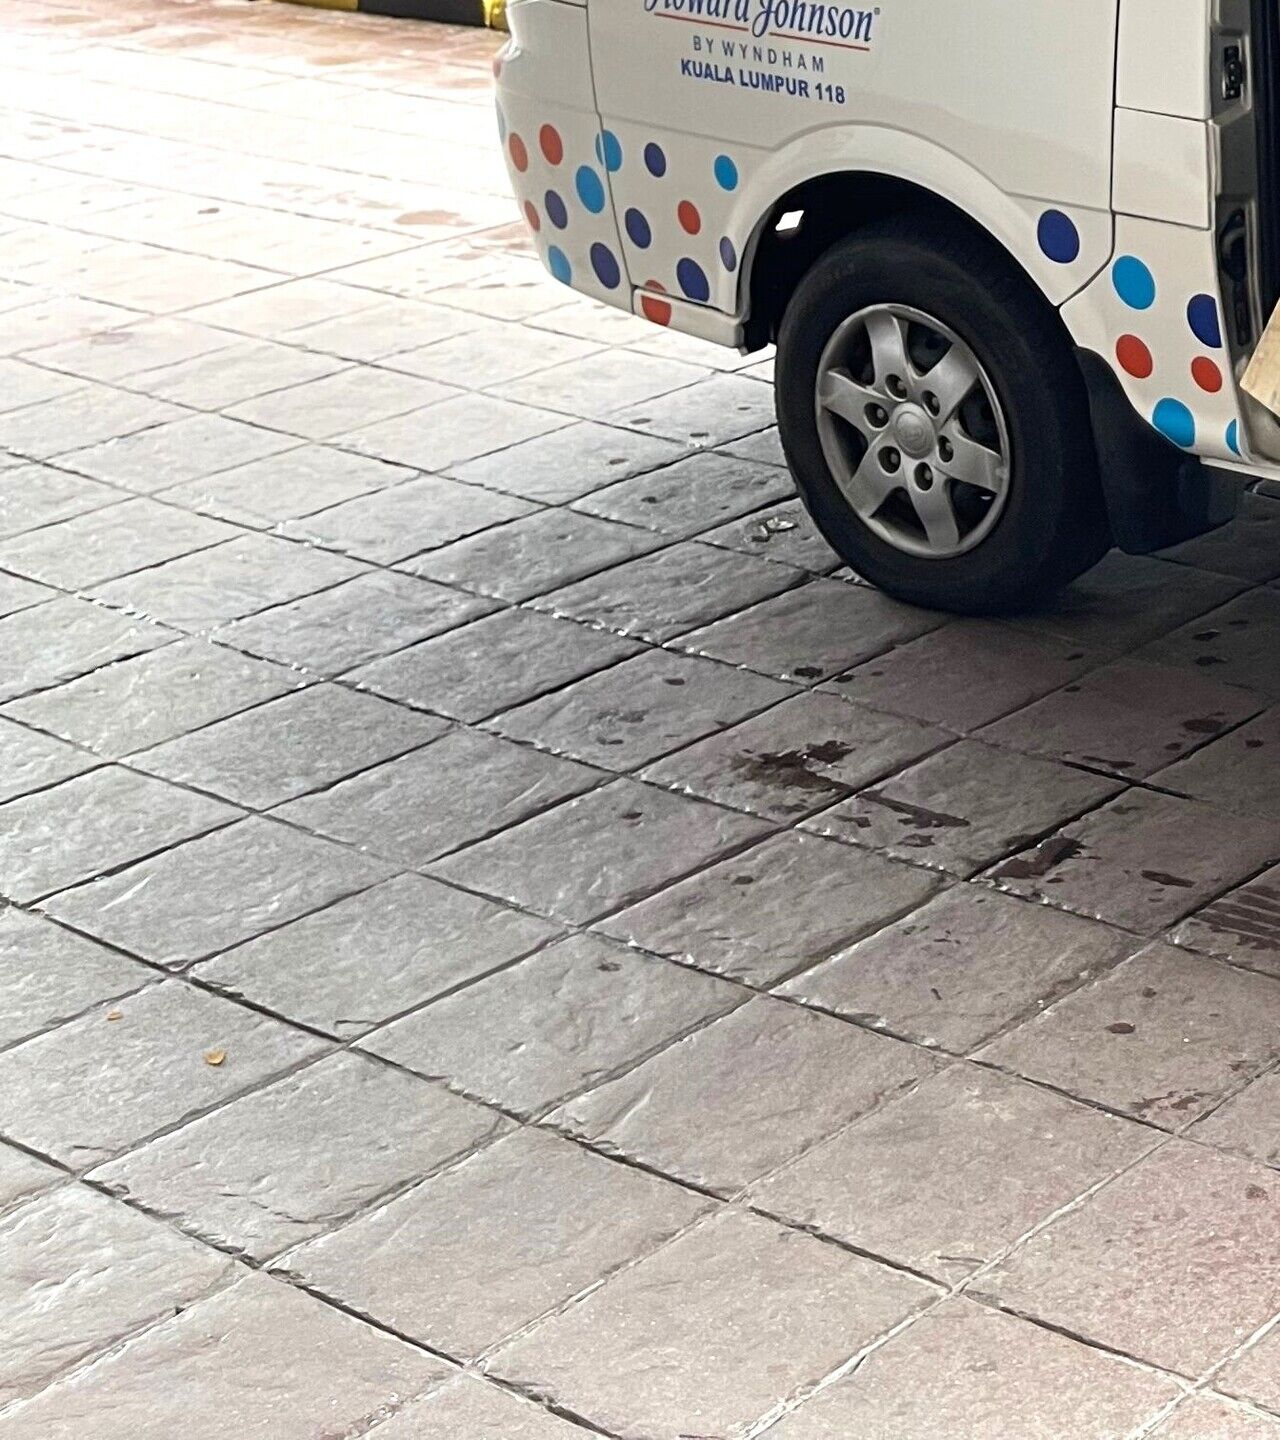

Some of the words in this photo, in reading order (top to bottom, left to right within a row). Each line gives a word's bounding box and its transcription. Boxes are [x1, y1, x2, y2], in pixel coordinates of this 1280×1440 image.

[693, 34, 714, 53] BY
[721, 39, 825, 74] WYNDHAM
[680, 57, 735, 86] KUALA
[738, 68, 810, 99] LUMPUR
[814, 82, 846, 105] 118
